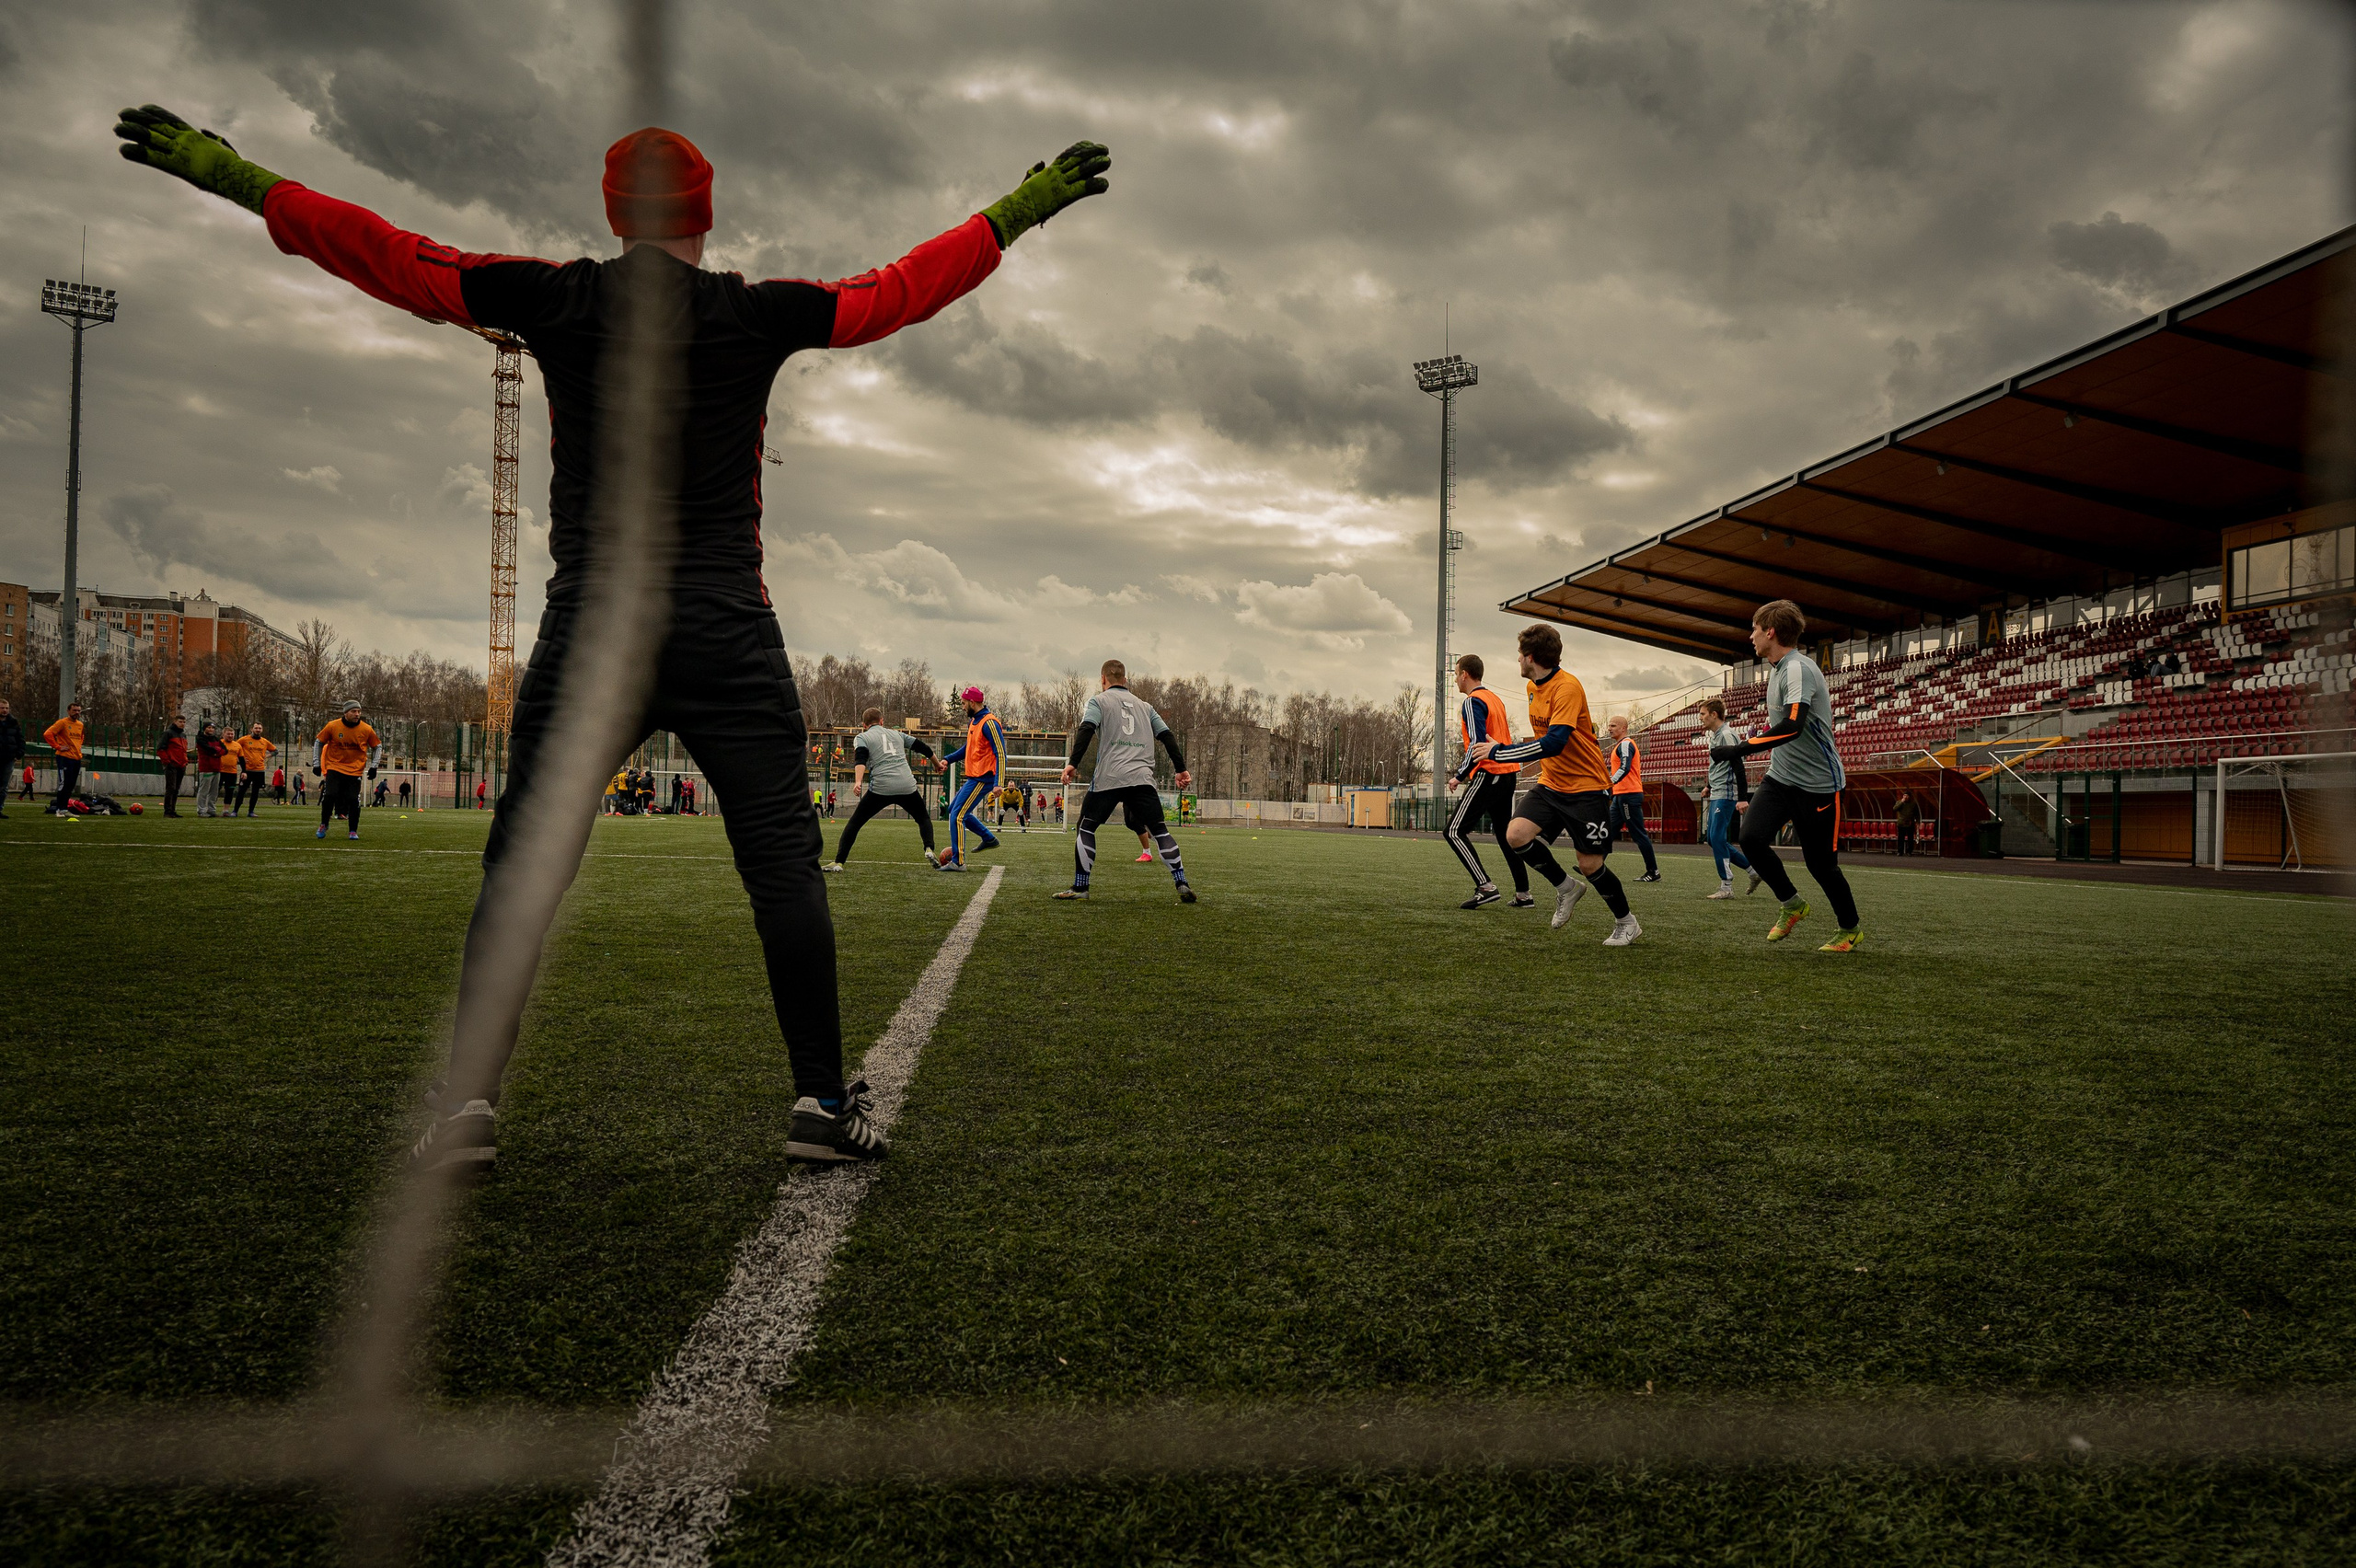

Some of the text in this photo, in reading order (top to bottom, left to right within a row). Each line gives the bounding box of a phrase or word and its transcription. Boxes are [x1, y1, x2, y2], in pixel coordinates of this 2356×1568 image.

[1121, 701, 1135, 735] 5
[881, 733, 897, 756] 4
[1586, 821, 1609, 839] 26
